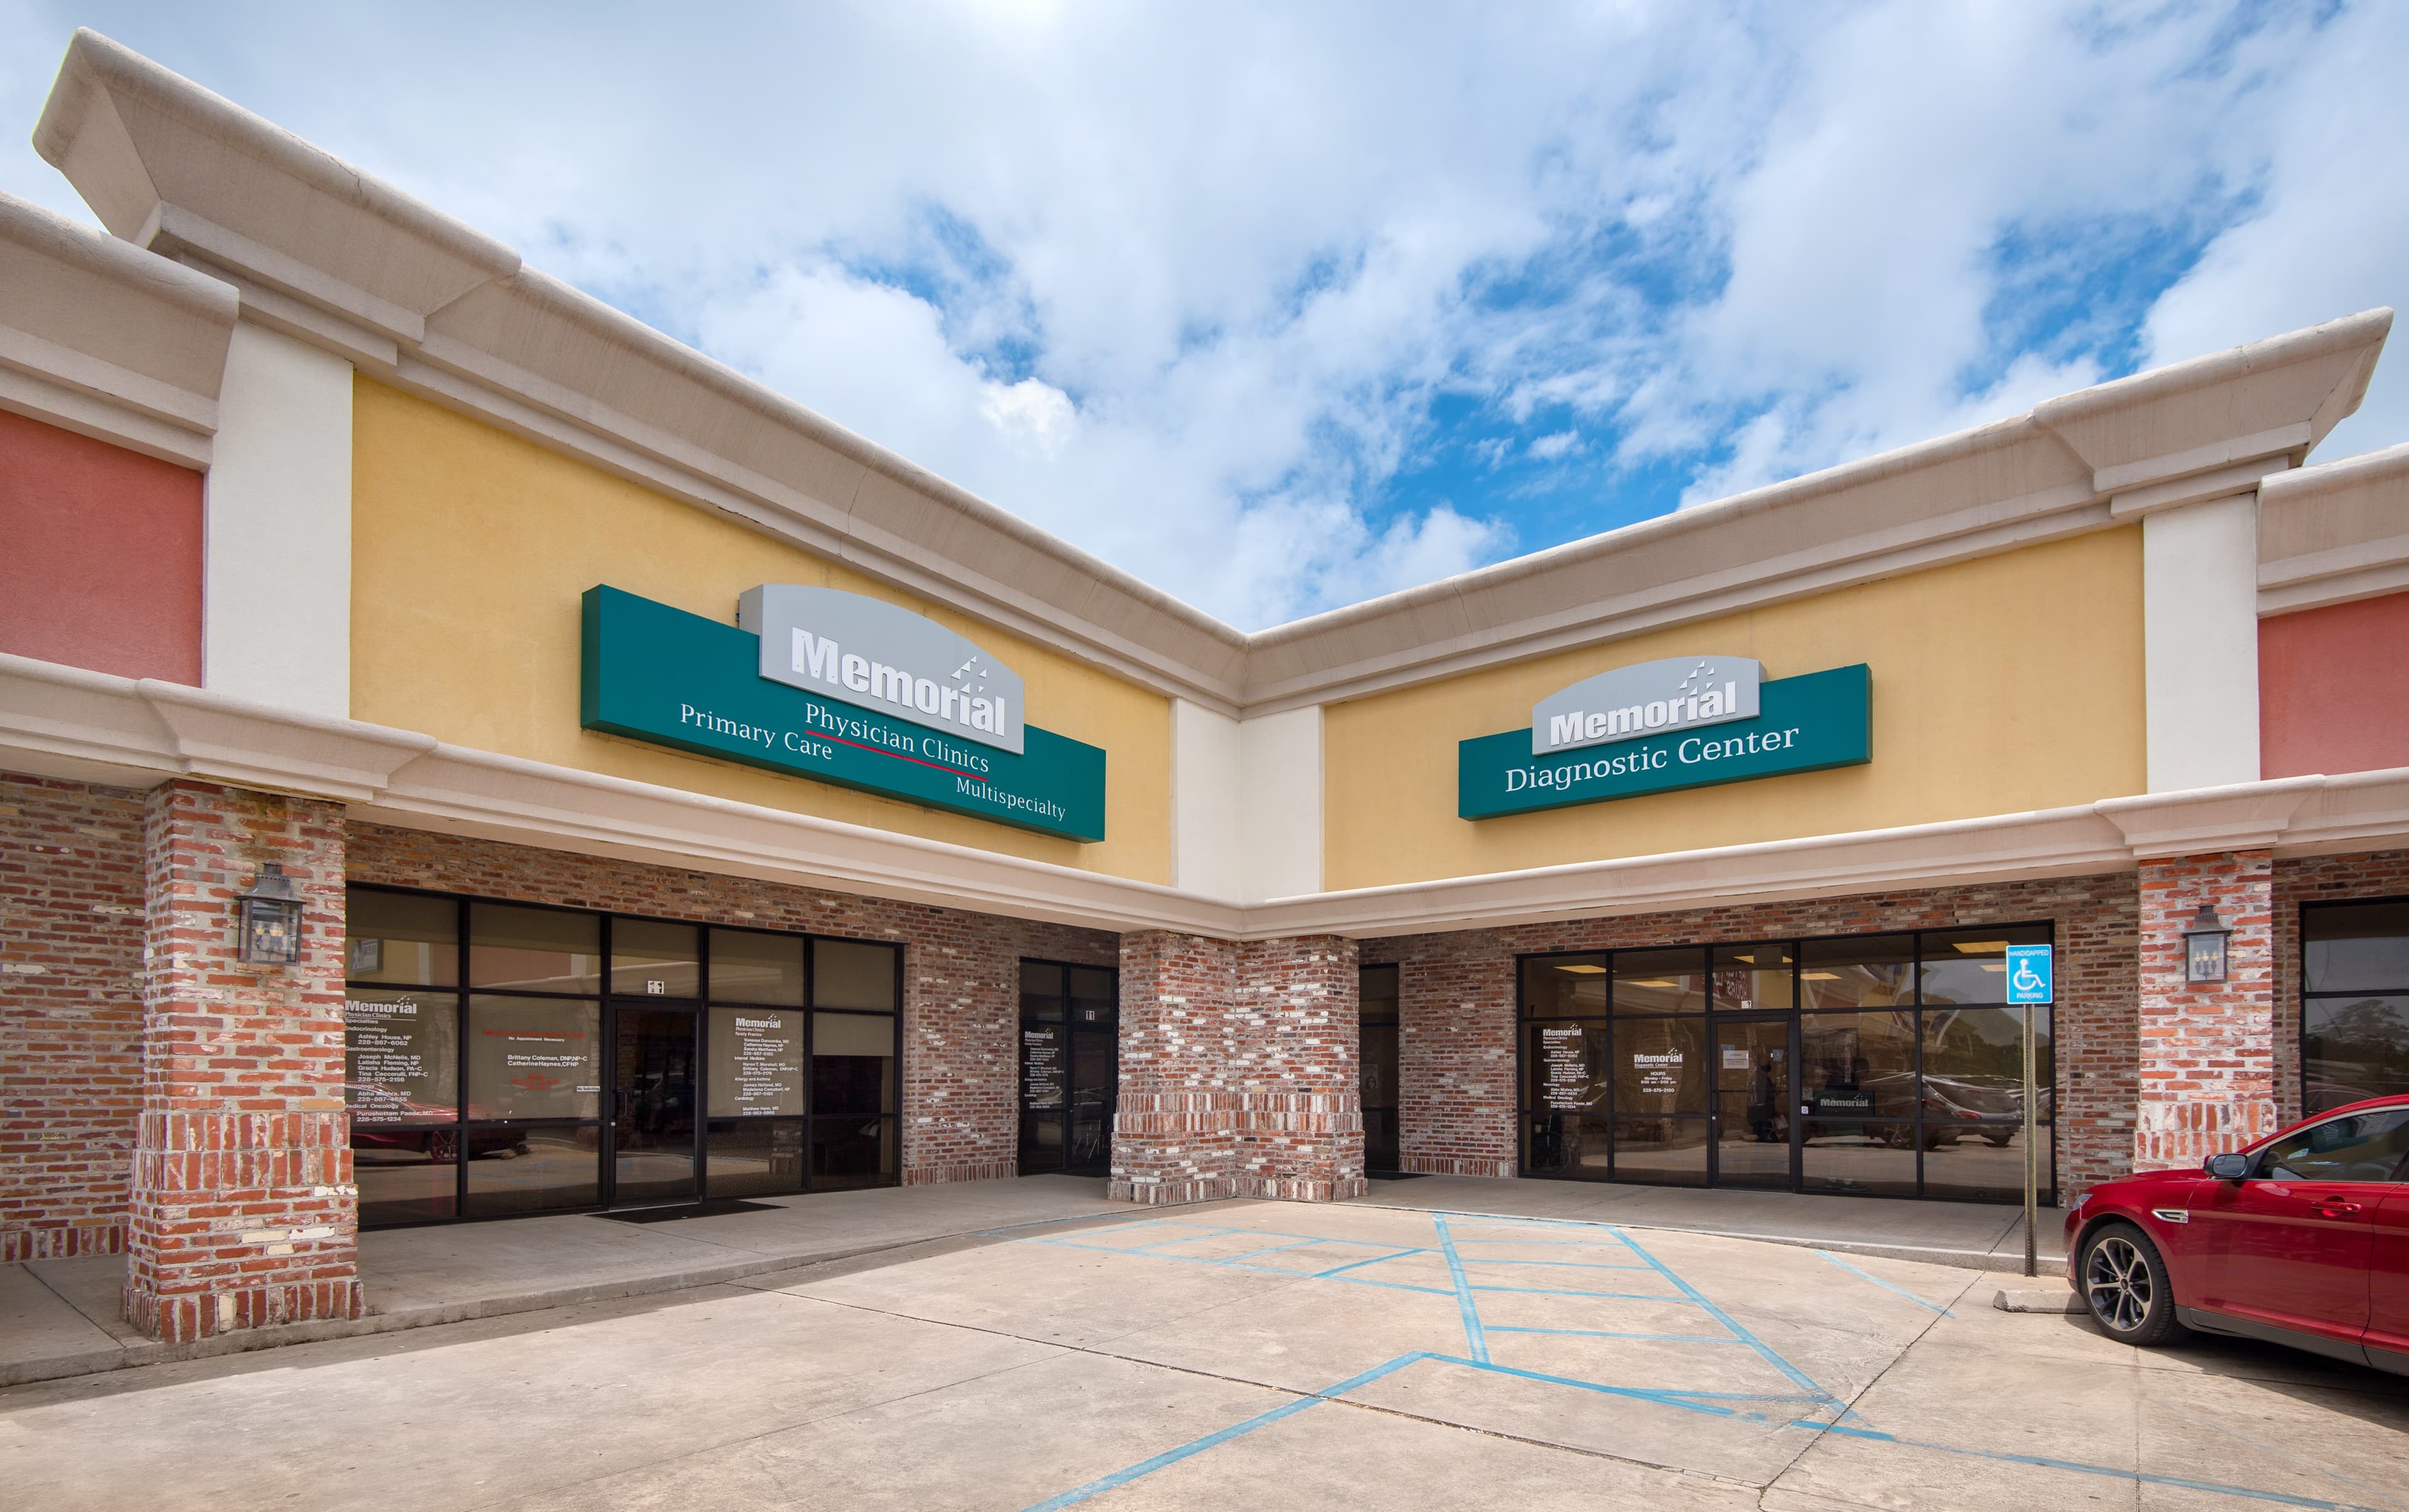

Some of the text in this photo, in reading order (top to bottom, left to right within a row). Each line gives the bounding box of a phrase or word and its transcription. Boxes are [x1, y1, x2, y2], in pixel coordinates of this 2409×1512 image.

[792, 627, 1005, 737] Memorial
[1550, 682, 1736, 745] Memorial
[680, 703, 832, 760] Primary Care
[806, 703, 989, 772] Physician Clinics
[1506, 727, 1799, 792] Diagnostic Center
[957, 777, 1066, 821] Multispecialty
[345, 1000, 417, 1014] Memorial
[1087, 1011, 1093, 1020] 11
[735, 1018, 781, 1028] Memorial
[1024, 1031, 1053, 1039] Memorial
[1634, 1054, 1683, 1063] Memorial
[1820, 1099, 1868, 1107] Memorial
